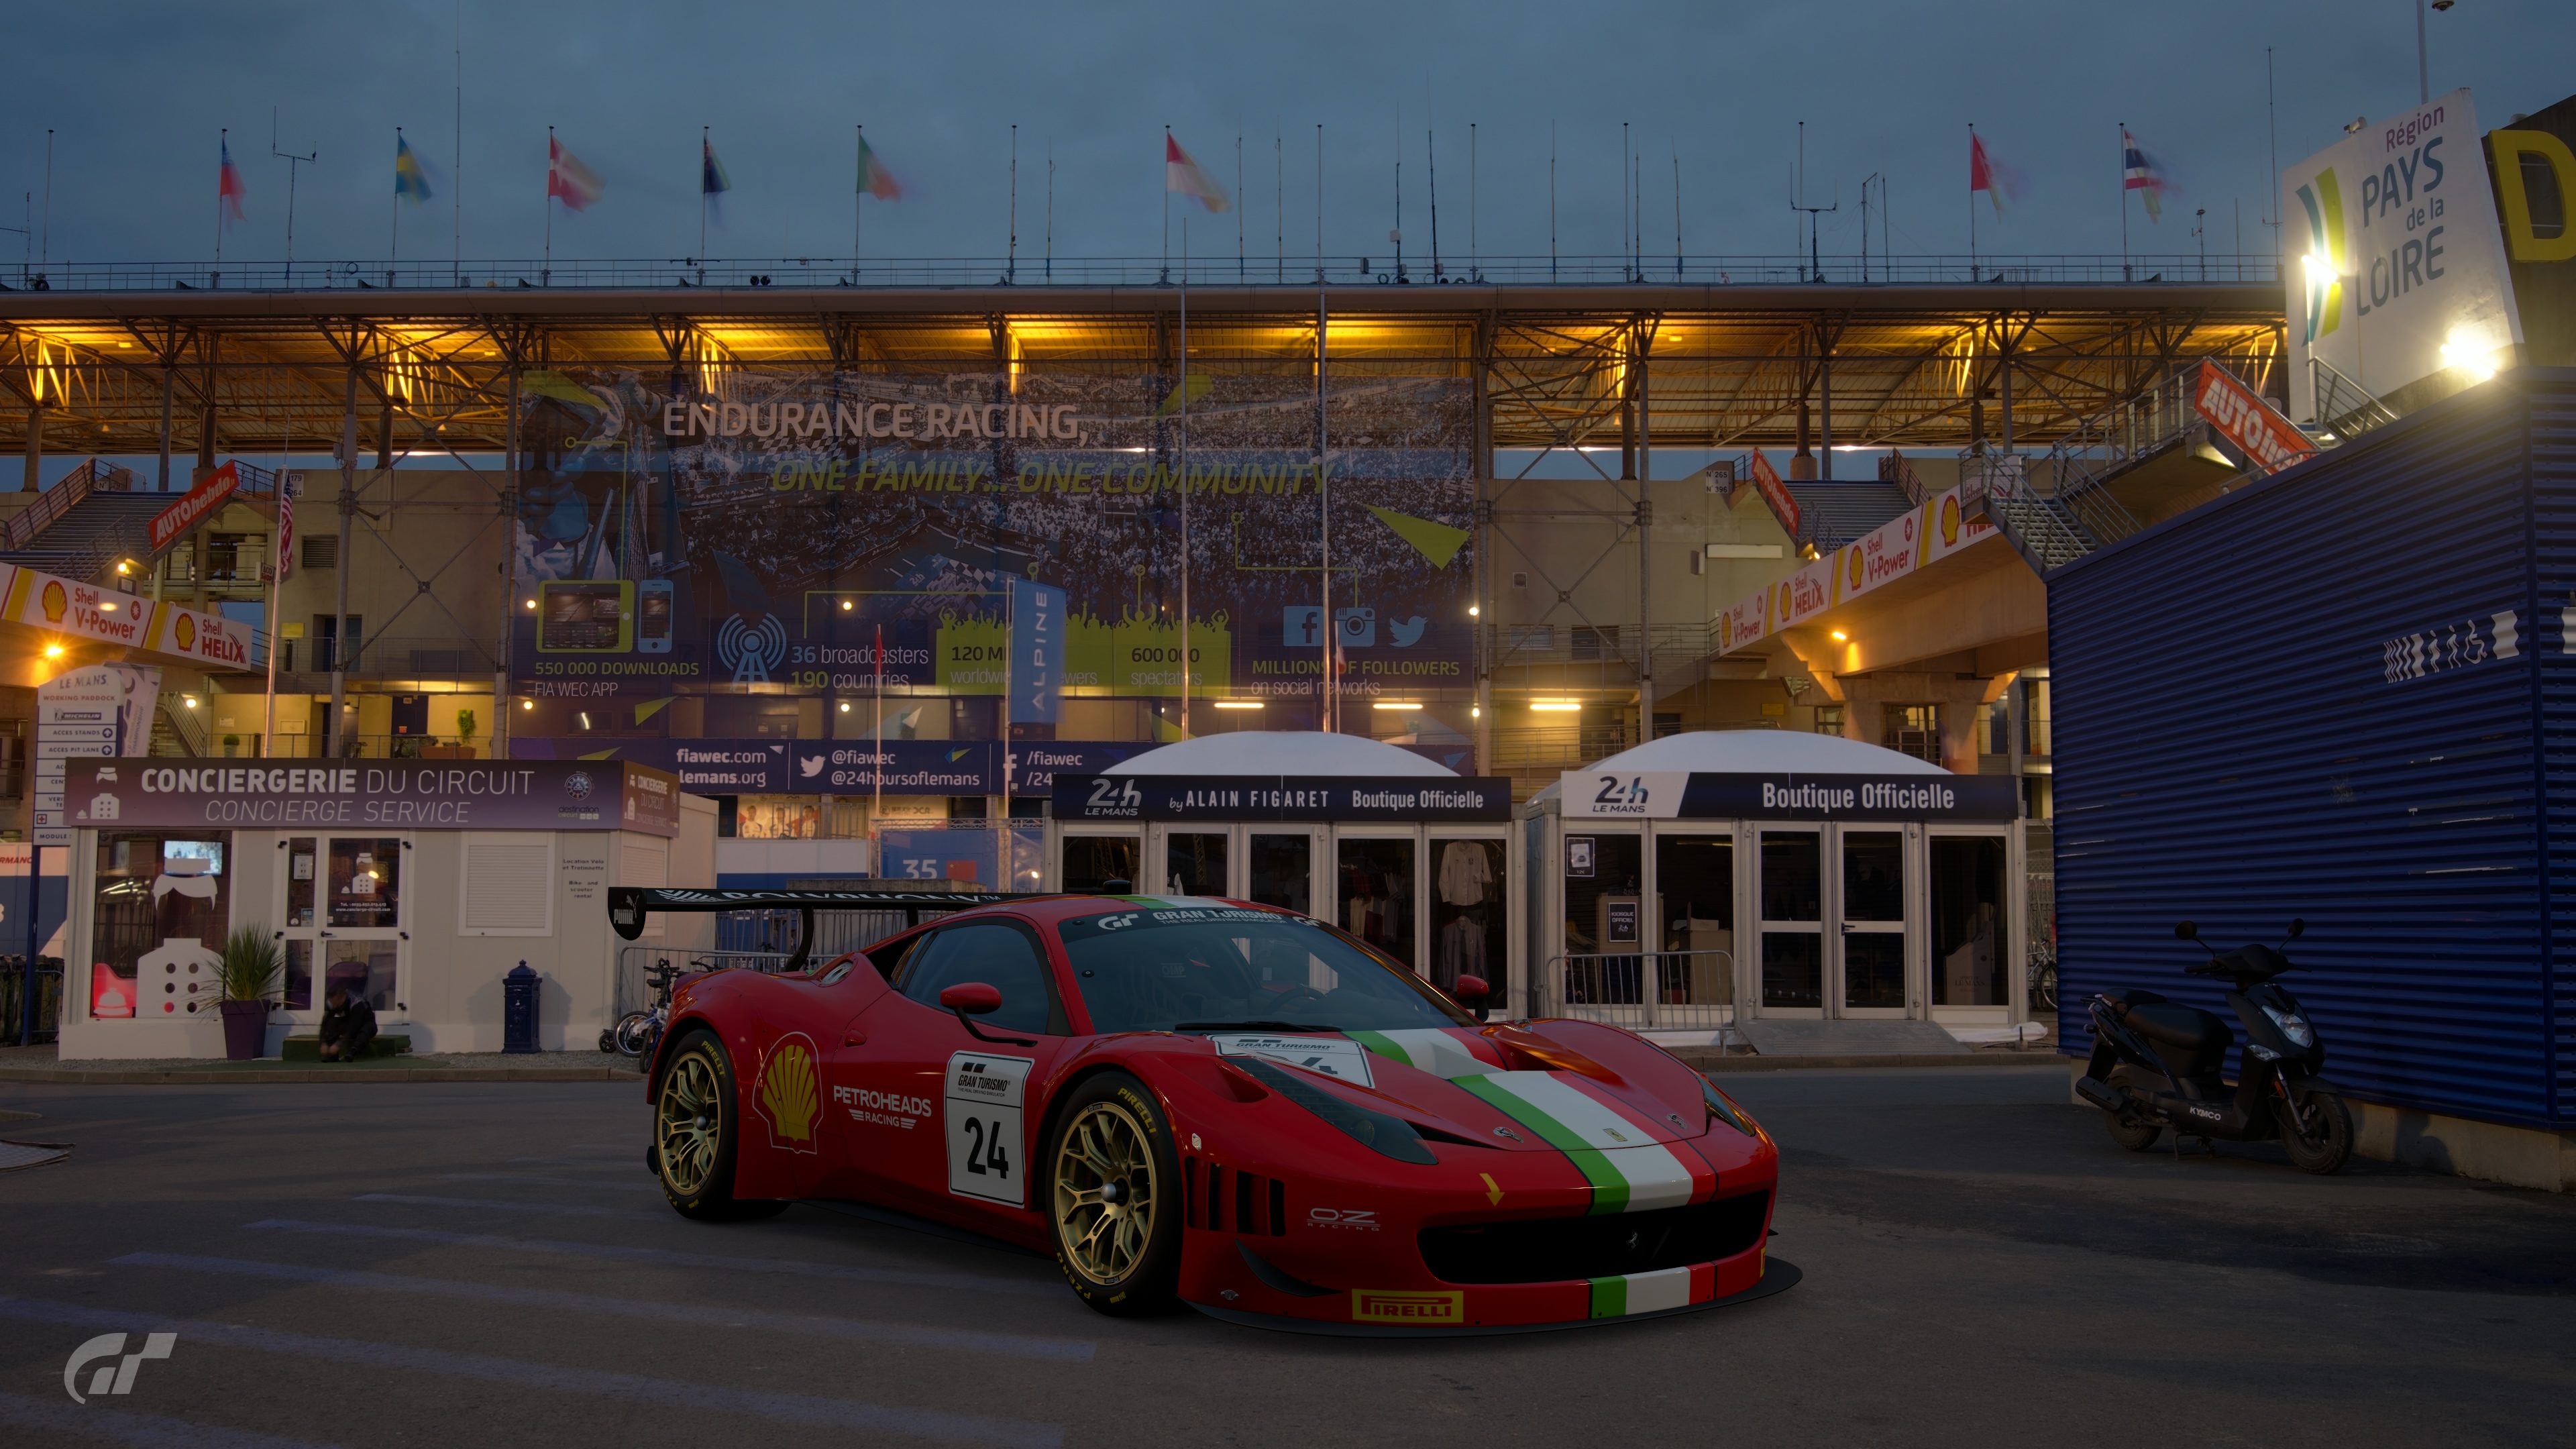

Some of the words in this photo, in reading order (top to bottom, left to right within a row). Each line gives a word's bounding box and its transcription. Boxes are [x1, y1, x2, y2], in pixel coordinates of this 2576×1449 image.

[2385, 106, 2445, 153] Région
[2361, 136, 2444, 227] PAYS
[2406, 207, 2426, 231] de
[2430, 197, 2445, 217] la
[2355, 225, 2445, 317] LOIRE
[928, 403, 1088, 445] RACING,
[773, 462, 847, 492] ONE
[855, 462, 1008, 492] FAMILY...
[1018, 462, 1096, 493] ONE
[1104, 463, 1333, 494] COMMUNITY
[1867, 533, 1883, 556] Shell
[1868, 549, 1910, 582] V-Power
[1794, 572, 1807, 592] Shell
[74, 588, 99, 606] Shell
[1794, 582, 1825, 616] HELIX
[74, 606, 136, 639] V-Power
[1733, 604, 1743, 622] Shell
[203, 619, 222, 636] Shell
[1733, 620, 1761, 643] V-Power
[202, 635, 246, 664] HELIX
[792, 646, 816, 663] 36
[821, 645, 929, 664] broadcasters
[951, 646, 983, 661] 120
[1032, 591, 1047, 713] ALPINE
[1132, 647, 1164, 663] 600
[535, 661, 564, 675] 550
[568, 661, 596, 675] 000
[601, 661, 699, 676] DOWNLOADS
[792, 671, 828, 688] 190
[1362, 661, 1460, 676] FOLLOWERS
[535, 682, 557, 697] FIA
[559, 682, 590, 697] WEC
[593, 682, 619, 697] APP
[1251, 682, 1269, 695] on
[1273, 678, 1312, 695] social
[676, 747, 767, 765] fiawec.com
[1026, 751, 1083, 766] /fiawec
[142, 767, 357, 794] CONCIERGERIE
[367, 769, 406, 794] DU
[417, 770, 535, 796] CIRCUIT
[679, 769, 767, 788] lemans.org
[831, 769, 981, 787] @24hoursoflemans
[1085, 778, 1142, 807] 24h
[1169, 796, 1183, 813] by
[1186, 790, 1238, 808] ALAIN
[1250, 790, 1329, 808] FIGARET
[1352, 790, 1415, 811] Boutique
[1419, 790, 1484, 809] Officielle
[1598, 775, 1648, 806] 24h
[1762, 783, 1855, 814] Boutique
[1862, 783, 1955, 810] Officielle
[205, 800, 353, 823] CONCIERGE
[364, 800, 471, 824] SERVICE
[1085, 808, 1101, 816] LE
[1103, 808, 1138, 816] MANS
[1593, 805, 1608, 813] LE
[1610, 805, 1646, 813] MANS
[902, 859, 938, 879] 35
[1152, 910, 1205, 920] GRAN
[1207, 909, 1283, 921] TURISMO
[702, 1040, 725, 1076] PIRELLI
[958, 1074, 977, 1087] GRAN
[833, 1084, 932, 1118] PETROHEADS
[1118, 1087, 1157, 1134] PIRELLI
[864, 1112, 900, 1128] RACING
[2189, 1106, 2222, 1122] KYMCO
[964, 1116, 1010, 1180] 24
[1306, 1223, 1380, 1232] RACING
[1360, 1295, 1452, 1318] PIRELLI
